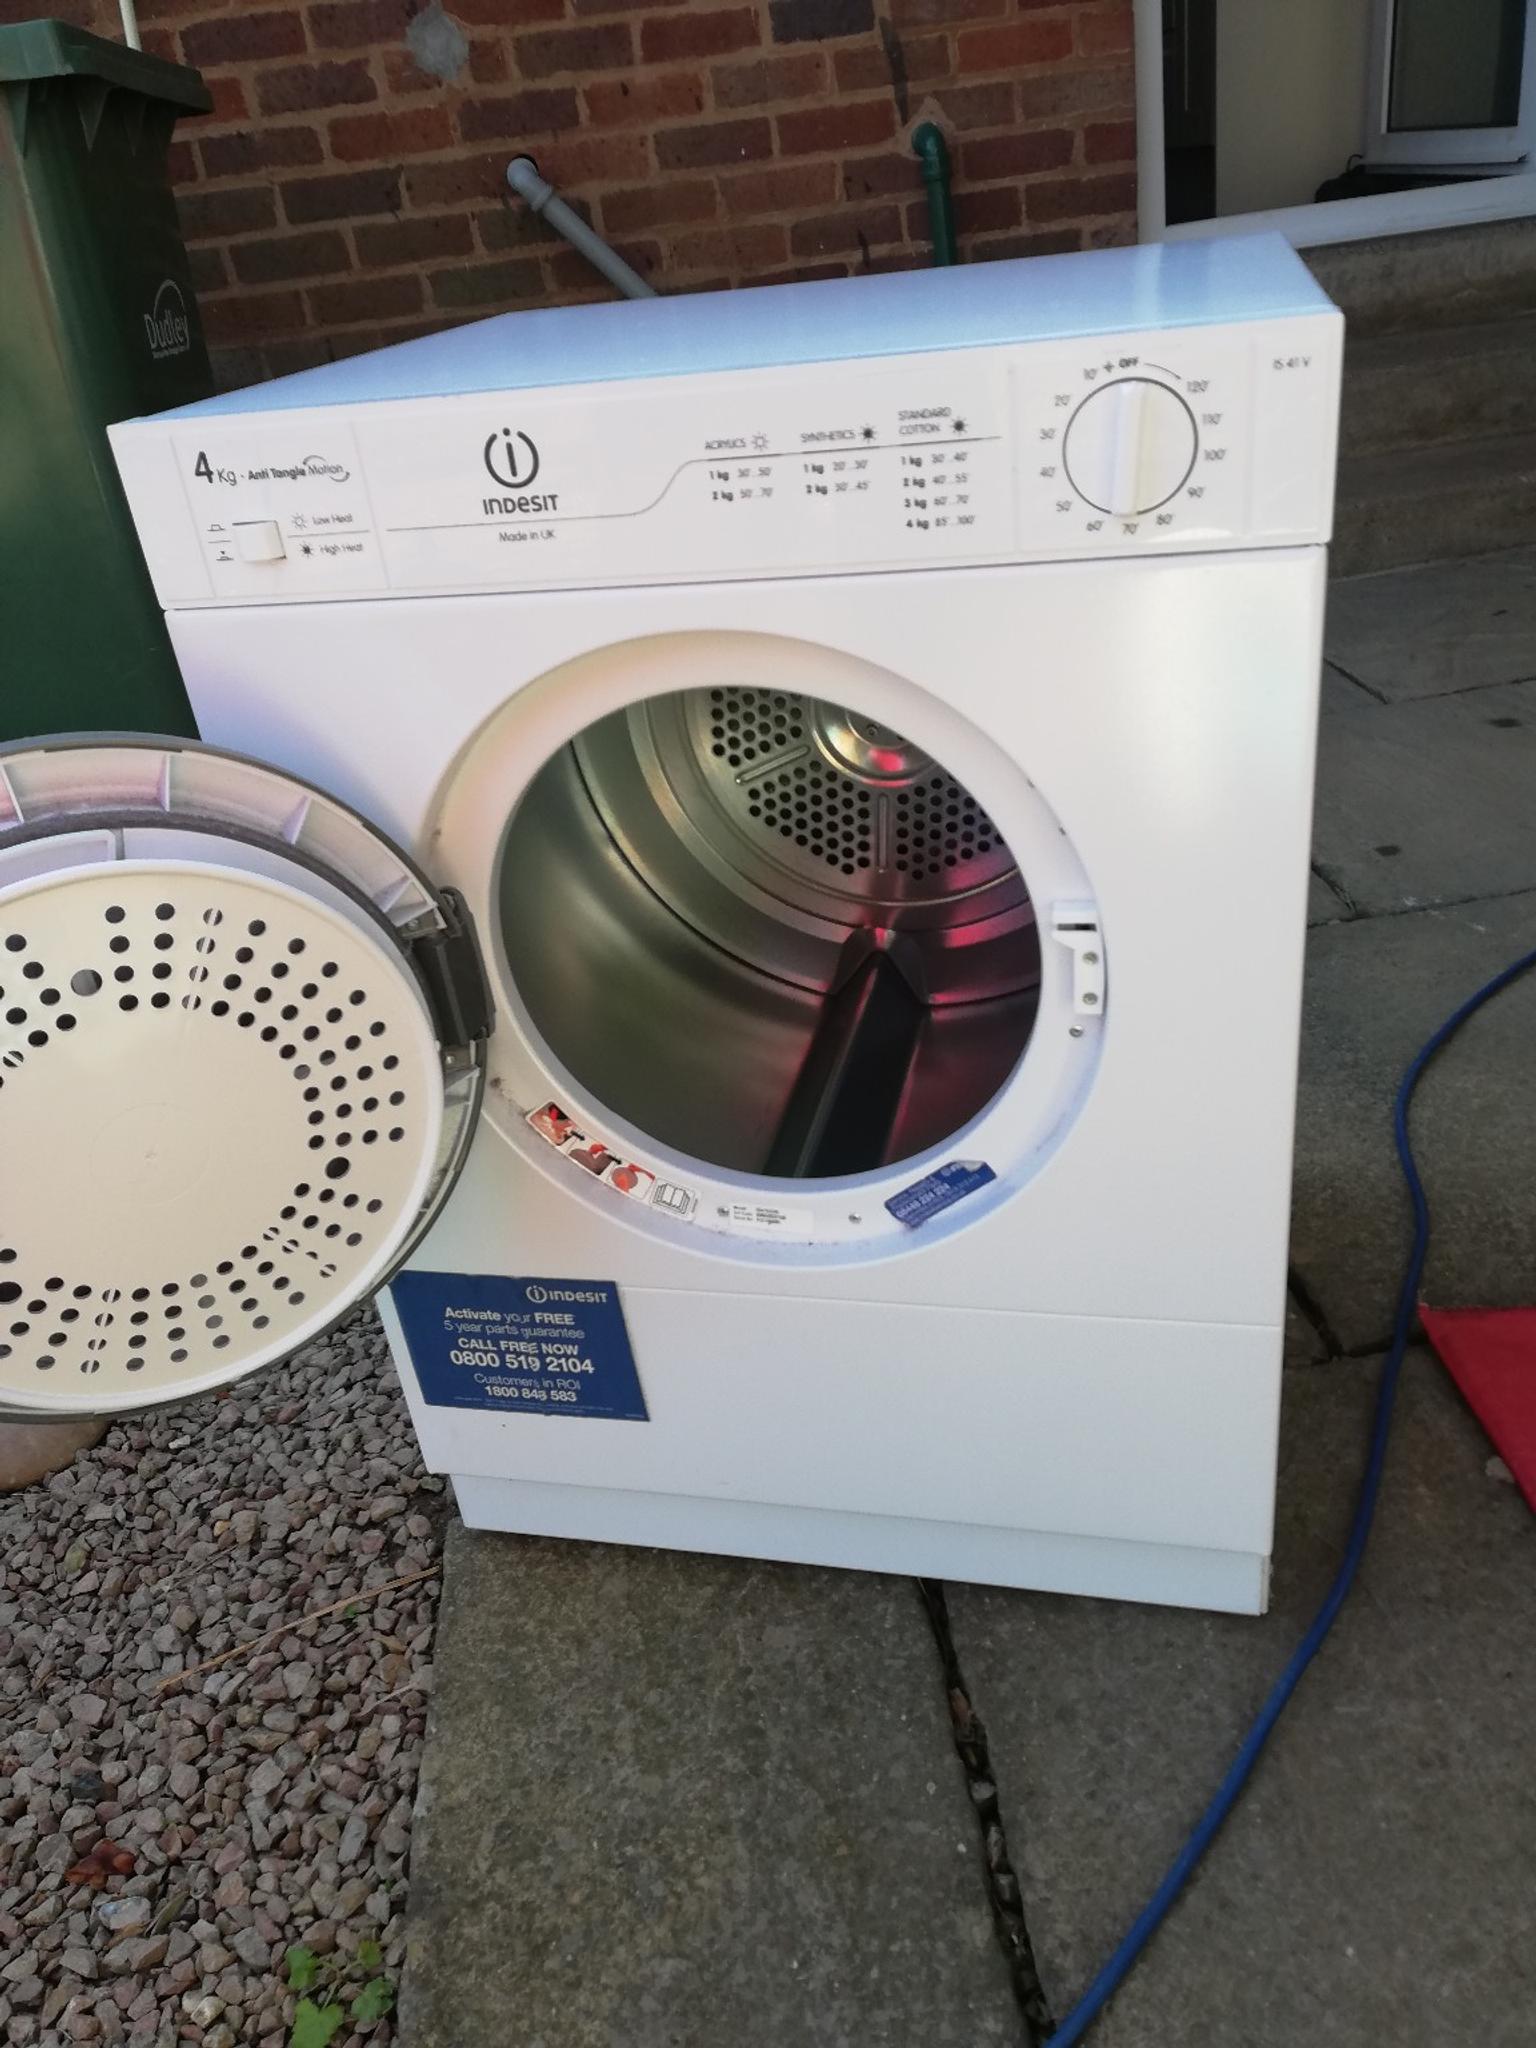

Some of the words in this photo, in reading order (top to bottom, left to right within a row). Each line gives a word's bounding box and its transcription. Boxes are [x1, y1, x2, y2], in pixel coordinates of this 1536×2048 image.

[144, 309, 189, 350] Dudley
[1119, 357, 1139, 368] OFF
[898, 423, 940, 435] COTTON
[195, 451, 214, 483] 4
[217, 468, 238, 486] Kg
[248, 468, 270, 480] Anti
[270, 465, 306, 481] Tangle
[308, 464, 344, 476] Motion
[312, 516, 330, 525] Low
[331, 512, 353, 523] Heat
[500, 531, 527, 542] Made
[530, 531, 539, 540] in
[541, 529, 556, 539] UK
[320, 544, 341, 556] High
[342, 543, 363, 552] Heat
[445, 1307, 500, 1321] Activate
[504, 1312, 531, 1324] your
[534, 1312, 575, 1326] FREE
[444, 1320, 453, 1331] 5
[456, 1322, 481, 1333] year
[486, 1325, 519, 1336] parts
[521, 1327, 585, 1339] guarantee
[458, 1337, 497, 1350] CALL
[500, 1340, 539, 1354] FREE
[542, 1343, 579, 1355] NOW
[450, 1350, 500, 1367] 0800
[546, 1356, 595, 1374] 2104
[474, 1372, 539, 1388] Customers
[543, 1378, 554, 1387] in
[556, 1379, 581, 1390] ROI
[485, 1385, 518, 1397] 1800
[550, 1390, 577, 1402] 583
